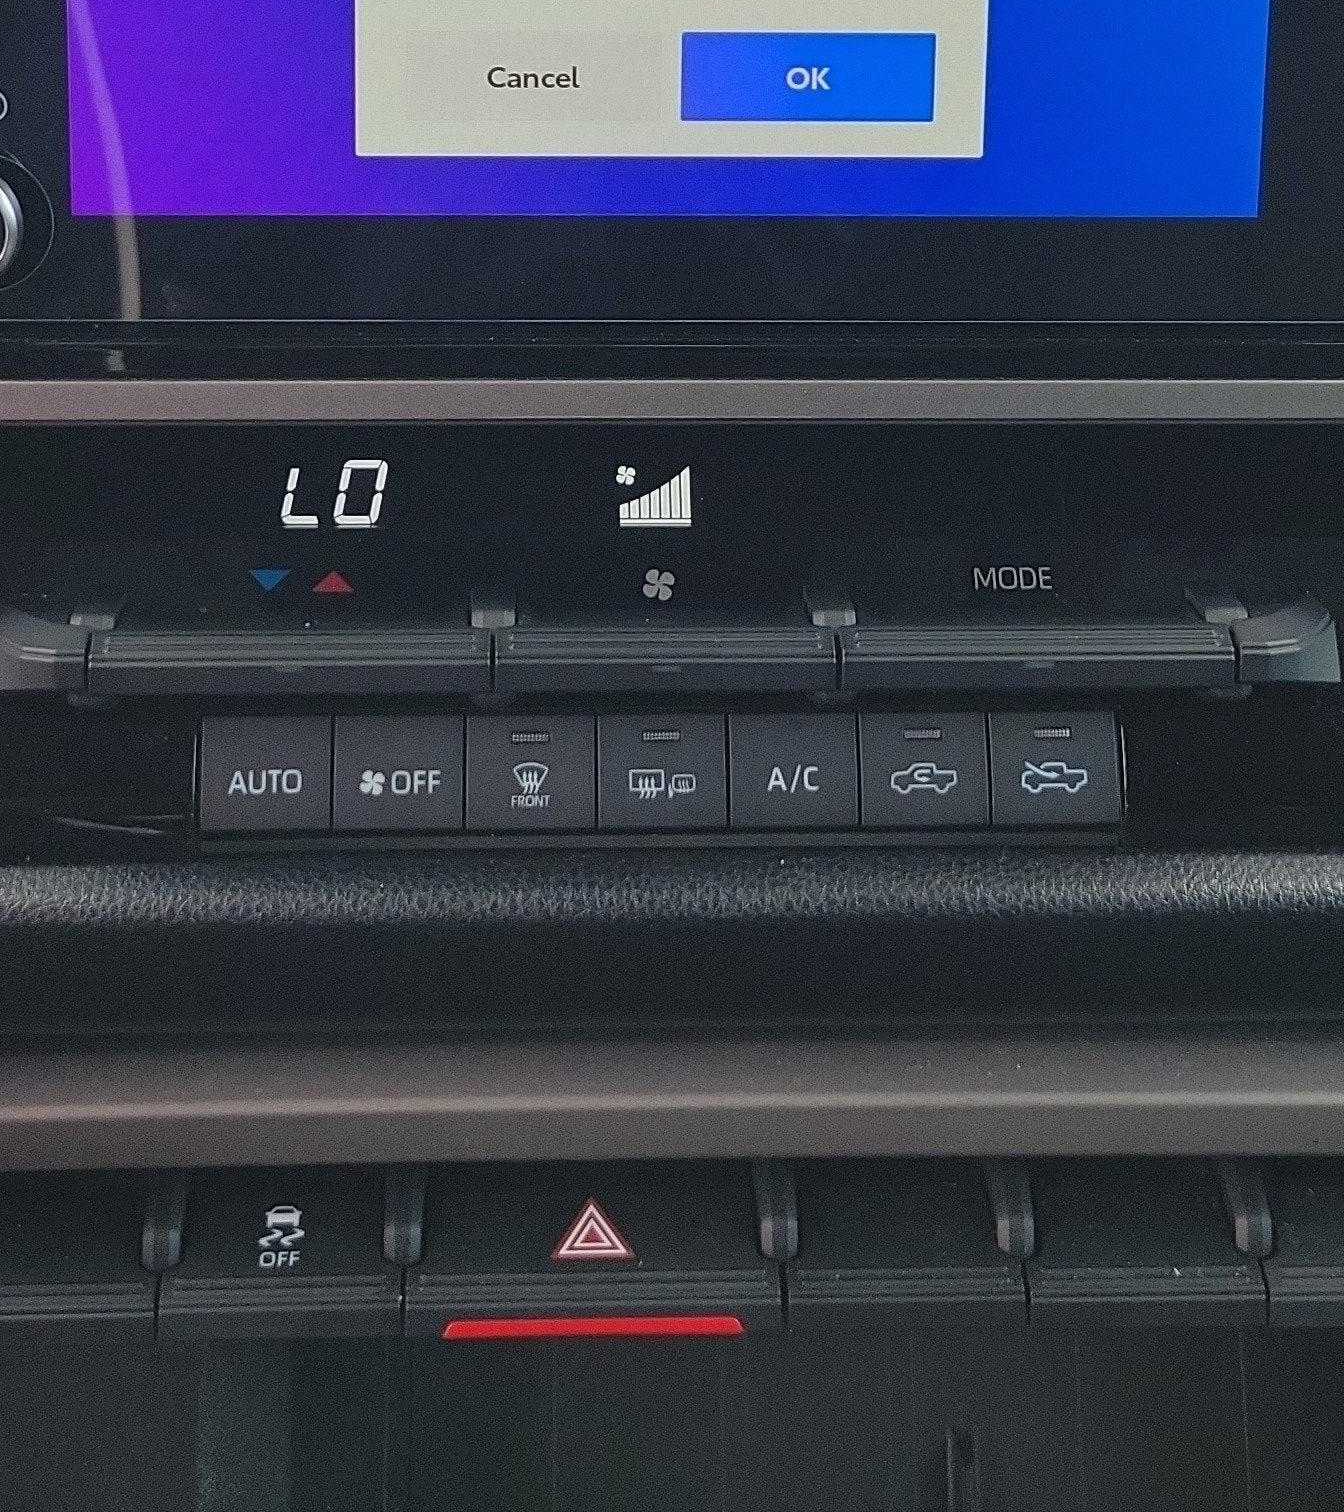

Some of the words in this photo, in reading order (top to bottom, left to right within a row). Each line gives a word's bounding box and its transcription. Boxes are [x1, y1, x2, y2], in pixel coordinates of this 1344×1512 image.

[486, 65, 581, 90] Cancel
[785, 67, 831, 91] OK
[972, 565, 1053, 591] MODE
[227, 768, 303, 795] AUTO
[390, 768, 442, 796] OFF
[767, 764, 820, 794] A/C
[510, 794, 551, 809] FRONT
[258, 1249, 301, 1269] OFF
